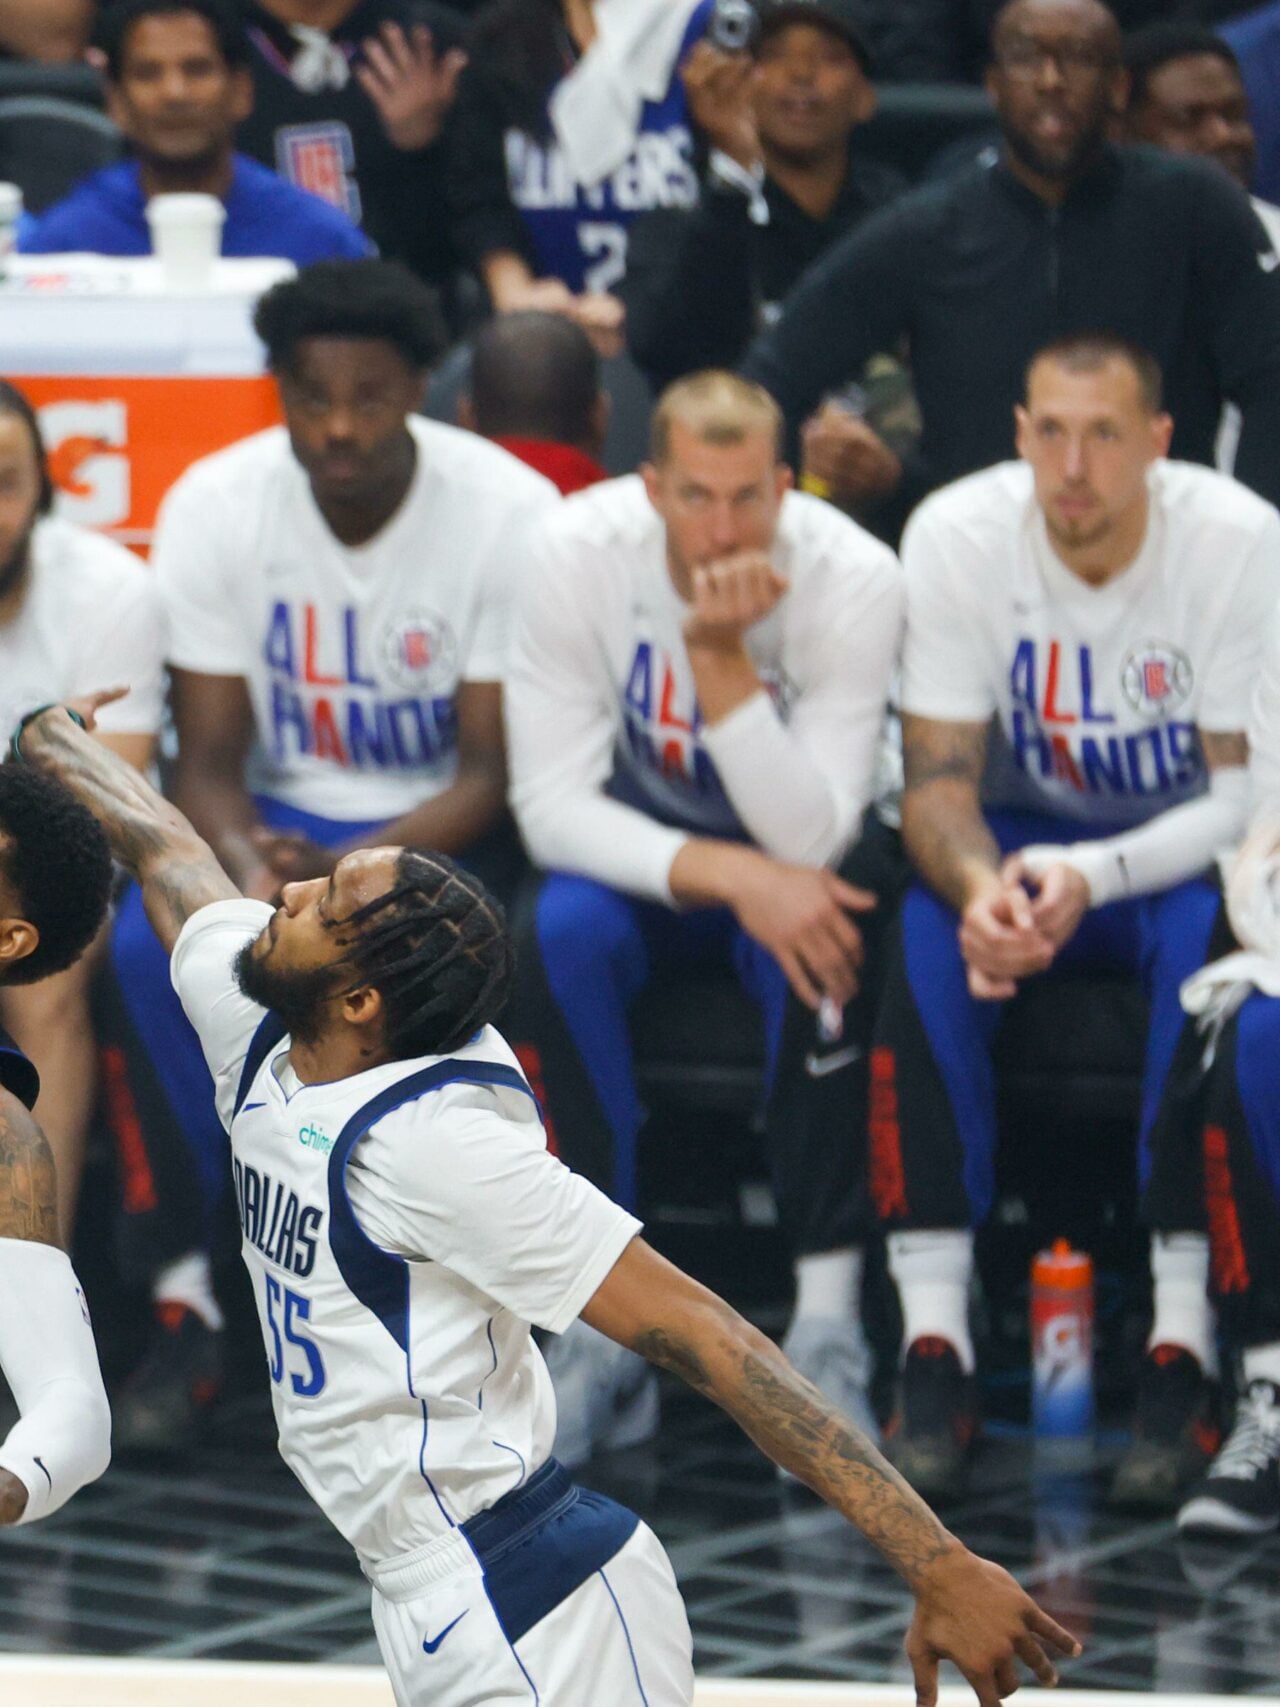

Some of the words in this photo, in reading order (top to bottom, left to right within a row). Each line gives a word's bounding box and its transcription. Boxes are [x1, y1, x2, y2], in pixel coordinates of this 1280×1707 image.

[576, 219, 628, 296] 2
[36, 398, 131, 527] G
[262, 600, 377, 687] ALL
[1010, 637, 1115, 724] ALL
[265, 1270, 326, 1398] 55
